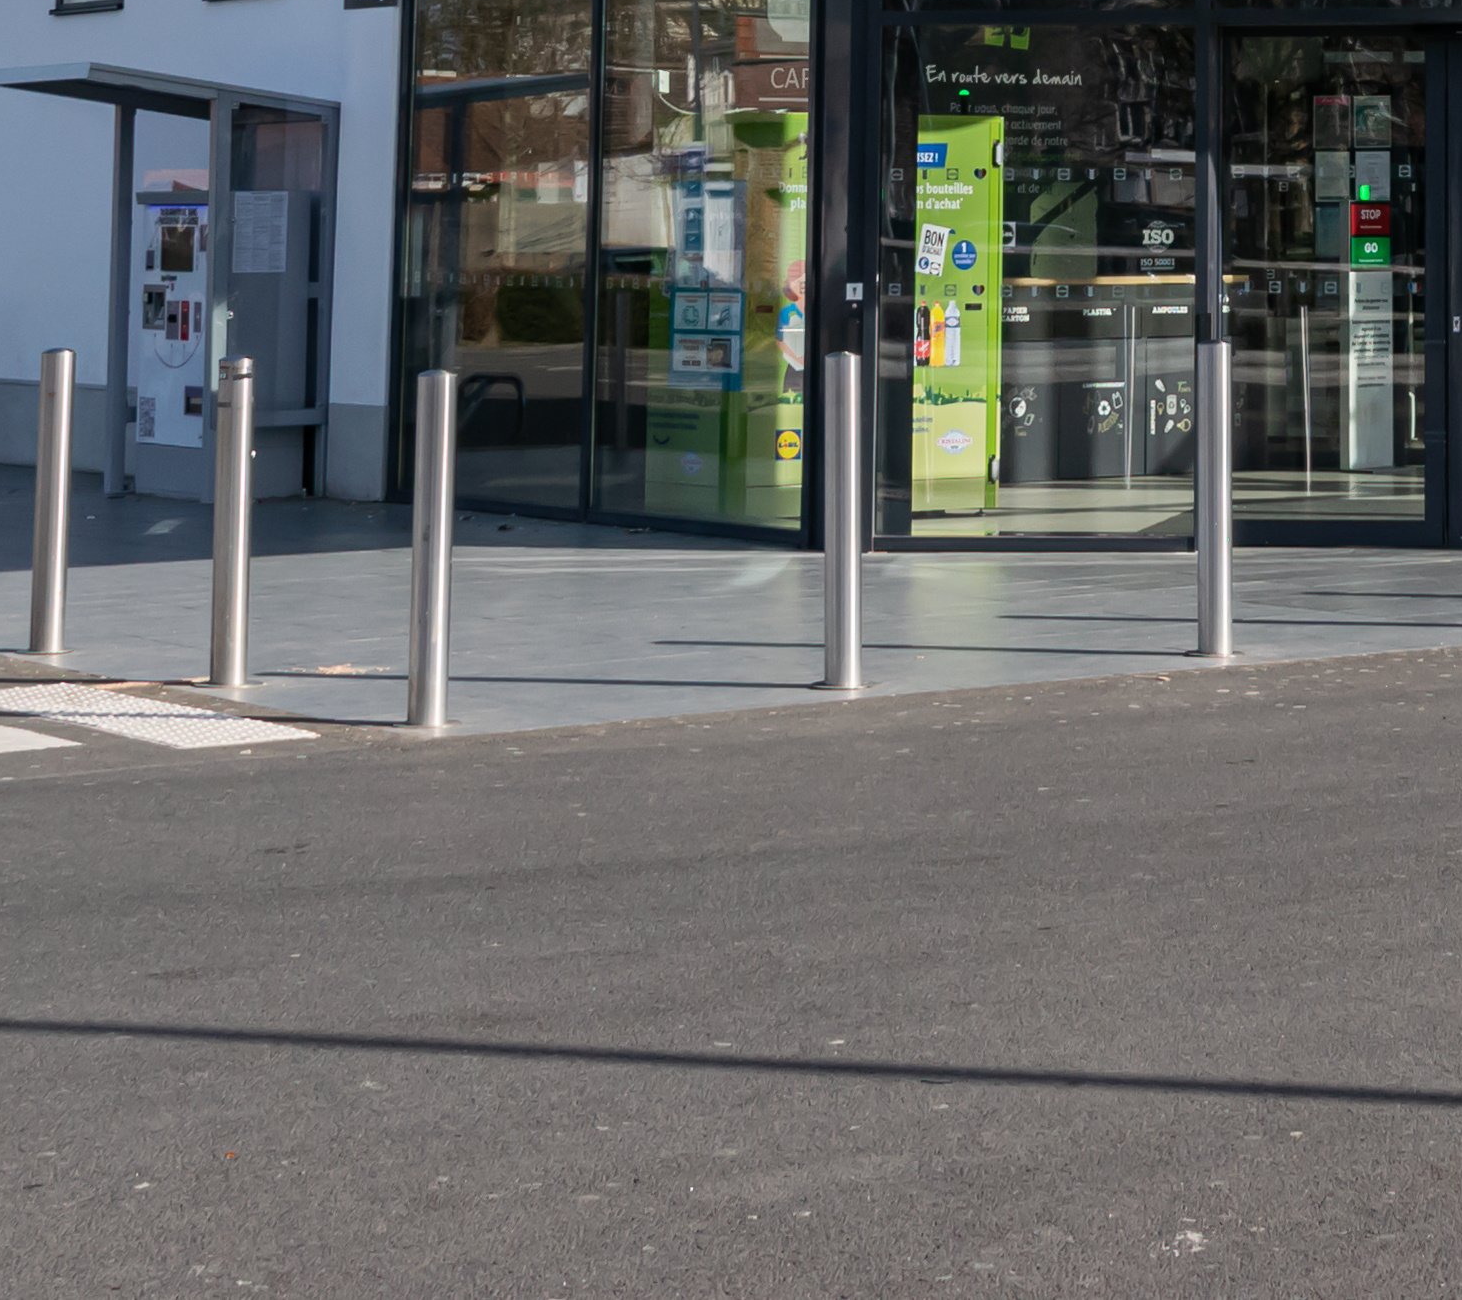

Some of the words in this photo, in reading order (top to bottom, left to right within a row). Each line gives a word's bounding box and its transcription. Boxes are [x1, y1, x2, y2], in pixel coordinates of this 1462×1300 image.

[925, 64, 947, 84] En
[951, 65, 991, 84] route
[995, 72, 1028, 85] vers
[1032, 69, 1083, 86] demain
[950, 102, 972, 114] Por
[1001, 103, 1036, 116] chaque
[1037, 104, 1058, 117] jour,
[1031, 135, 1042, 146] de
[1044, 136, 1069, 146] notre
[779, 182, 807, 193] Donn
[926, 182, 974, 195] bouteilles
[1360, 209, 1381, 220] STOP
[924, 229, 945, 247] BON
[1142, 229, 1175, 245] ISO
[961, 241, 967, 253] 1
[1364, 242, 1379, 254] GO
[1140, 258, 1153, 266] ISO
[1082, 307, 1117, 316] PLASTIQ
